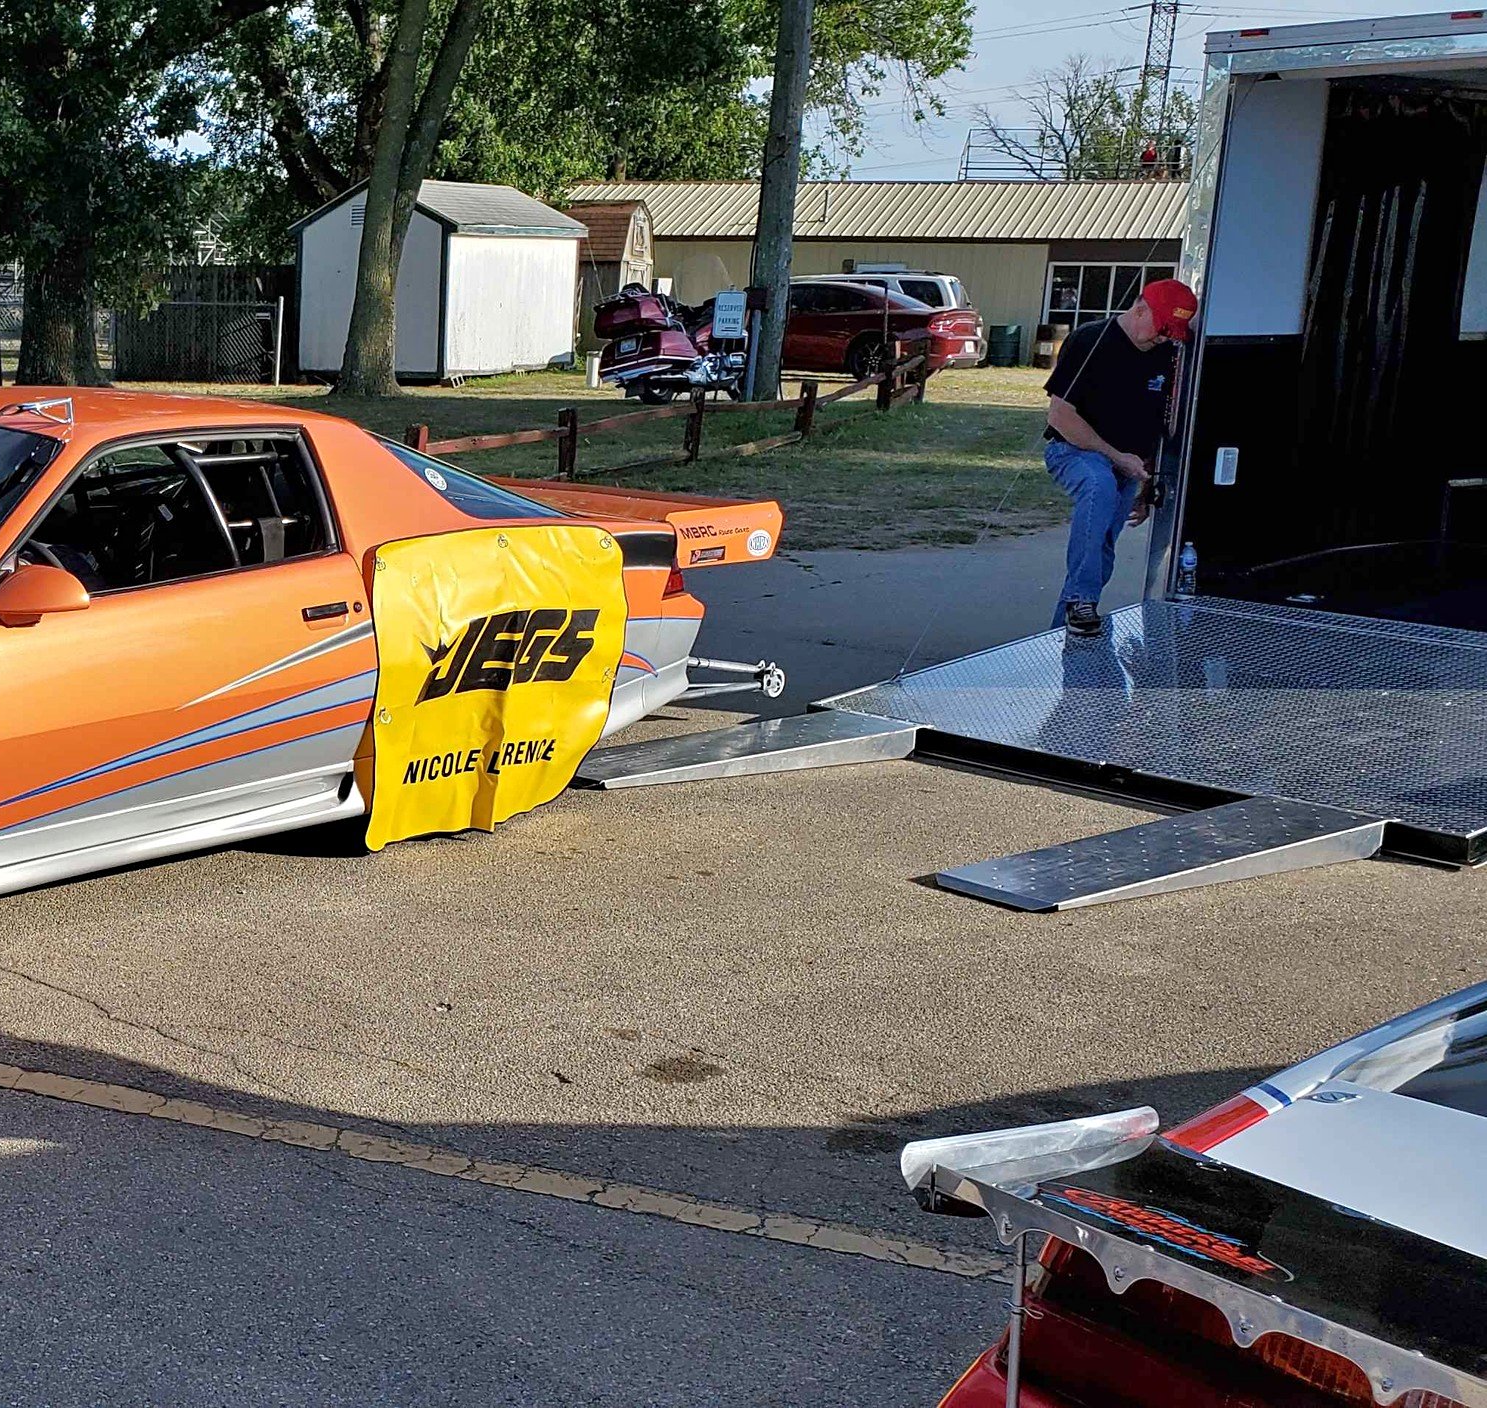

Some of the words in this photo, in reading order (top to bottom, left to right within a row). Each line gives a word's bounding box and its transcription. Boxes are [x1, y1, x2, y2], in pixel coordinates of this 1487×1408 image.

[718, 304, 742, 312] RESERVED
[679, 525, 717, 540] MBRC
[415, 609, 599, 706] JEGS
[402, 749, 481, 785] NICOLE
